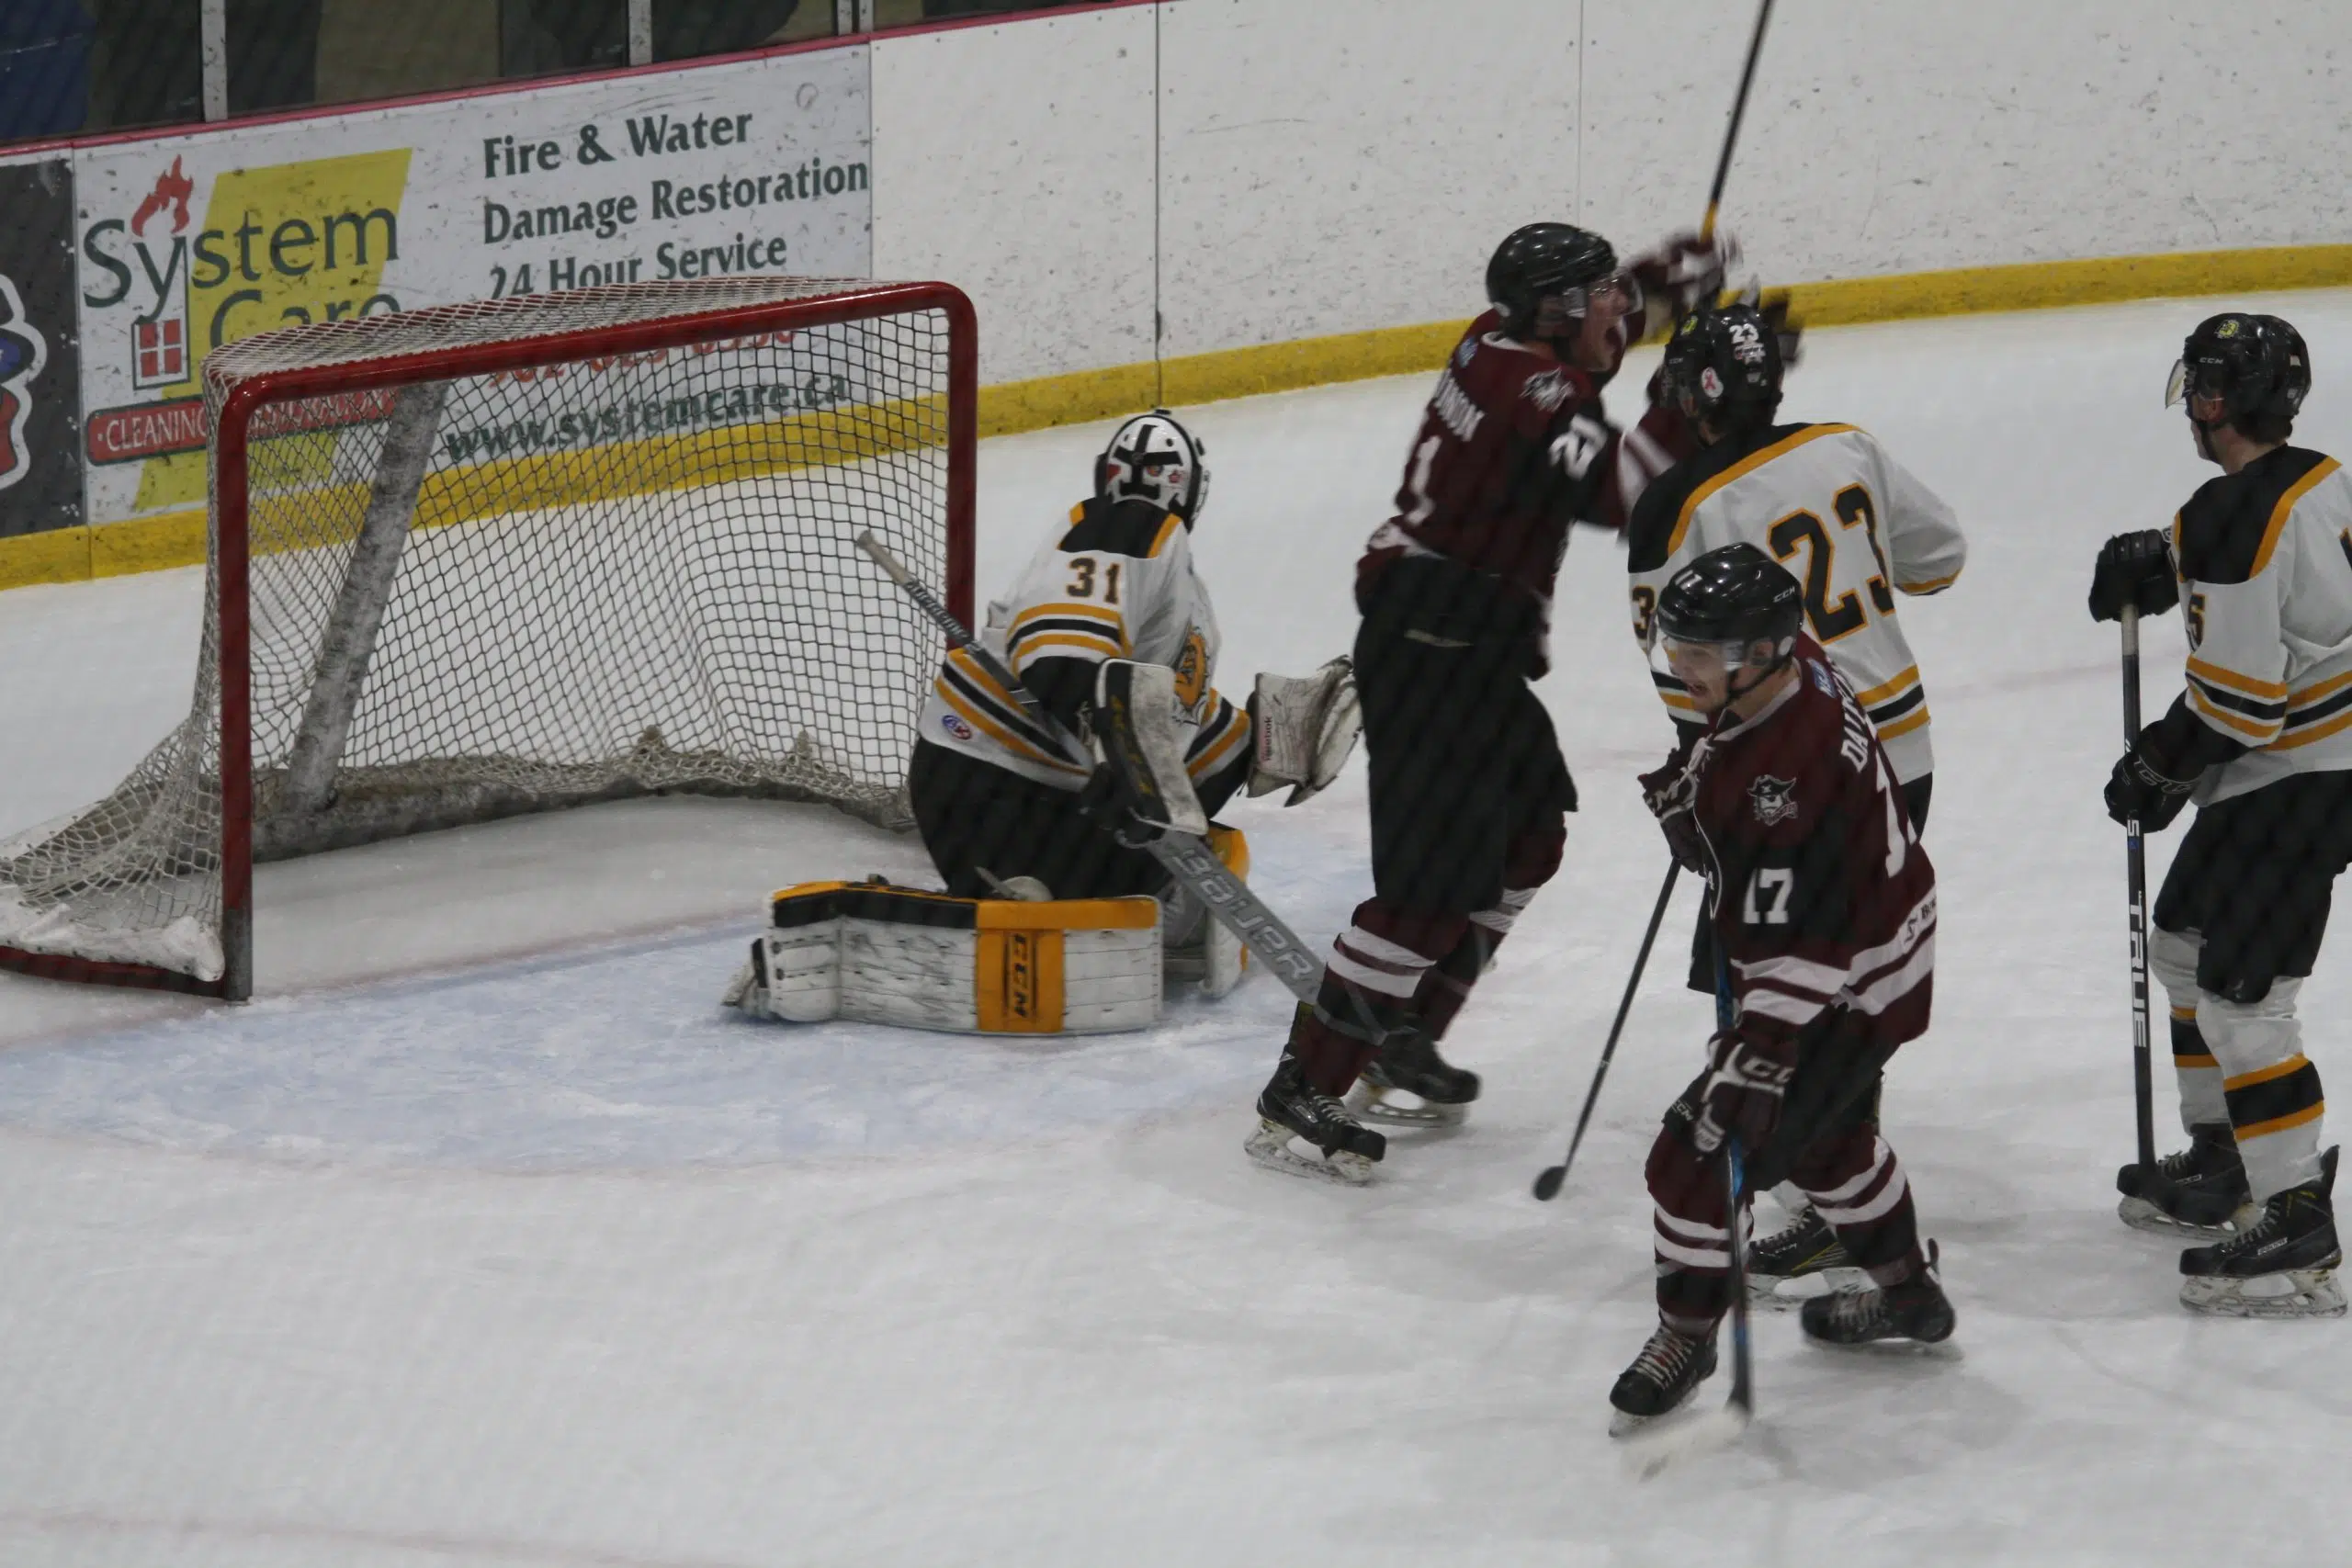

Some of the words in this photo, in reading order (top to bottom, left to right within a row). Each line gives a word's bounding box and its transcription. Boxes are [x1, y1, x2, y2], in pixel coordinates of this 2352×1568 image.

[483, 135, 561, 178] Fire
[576, 124, 616, 165] &
[626, 112, 752, 157] Water
[483, 195, 638, 243] Damage
[651, 157, 868, 220] Restoration
[83, 208, 400, 324] System
[490, 264, 534, 299] 24
[549, 256, 642, 291] Hour
[656, 232, 787, 279] Service
[1729, 323, 1759, 344] 23
[2199, 356, 2224, 365] CCM
[446, 372, 848, 461] www.systemcare.ca
[1066, 556, 1121, 605] 31
[1766, 481, 1897, 646] 23
[1772, 586, 1796, 604] CCM
[1171, 849, 1315, 980] BAUER
[1742, 866, 1794, 925] 17
[2129, 891, 2147, 1048] TRUE
